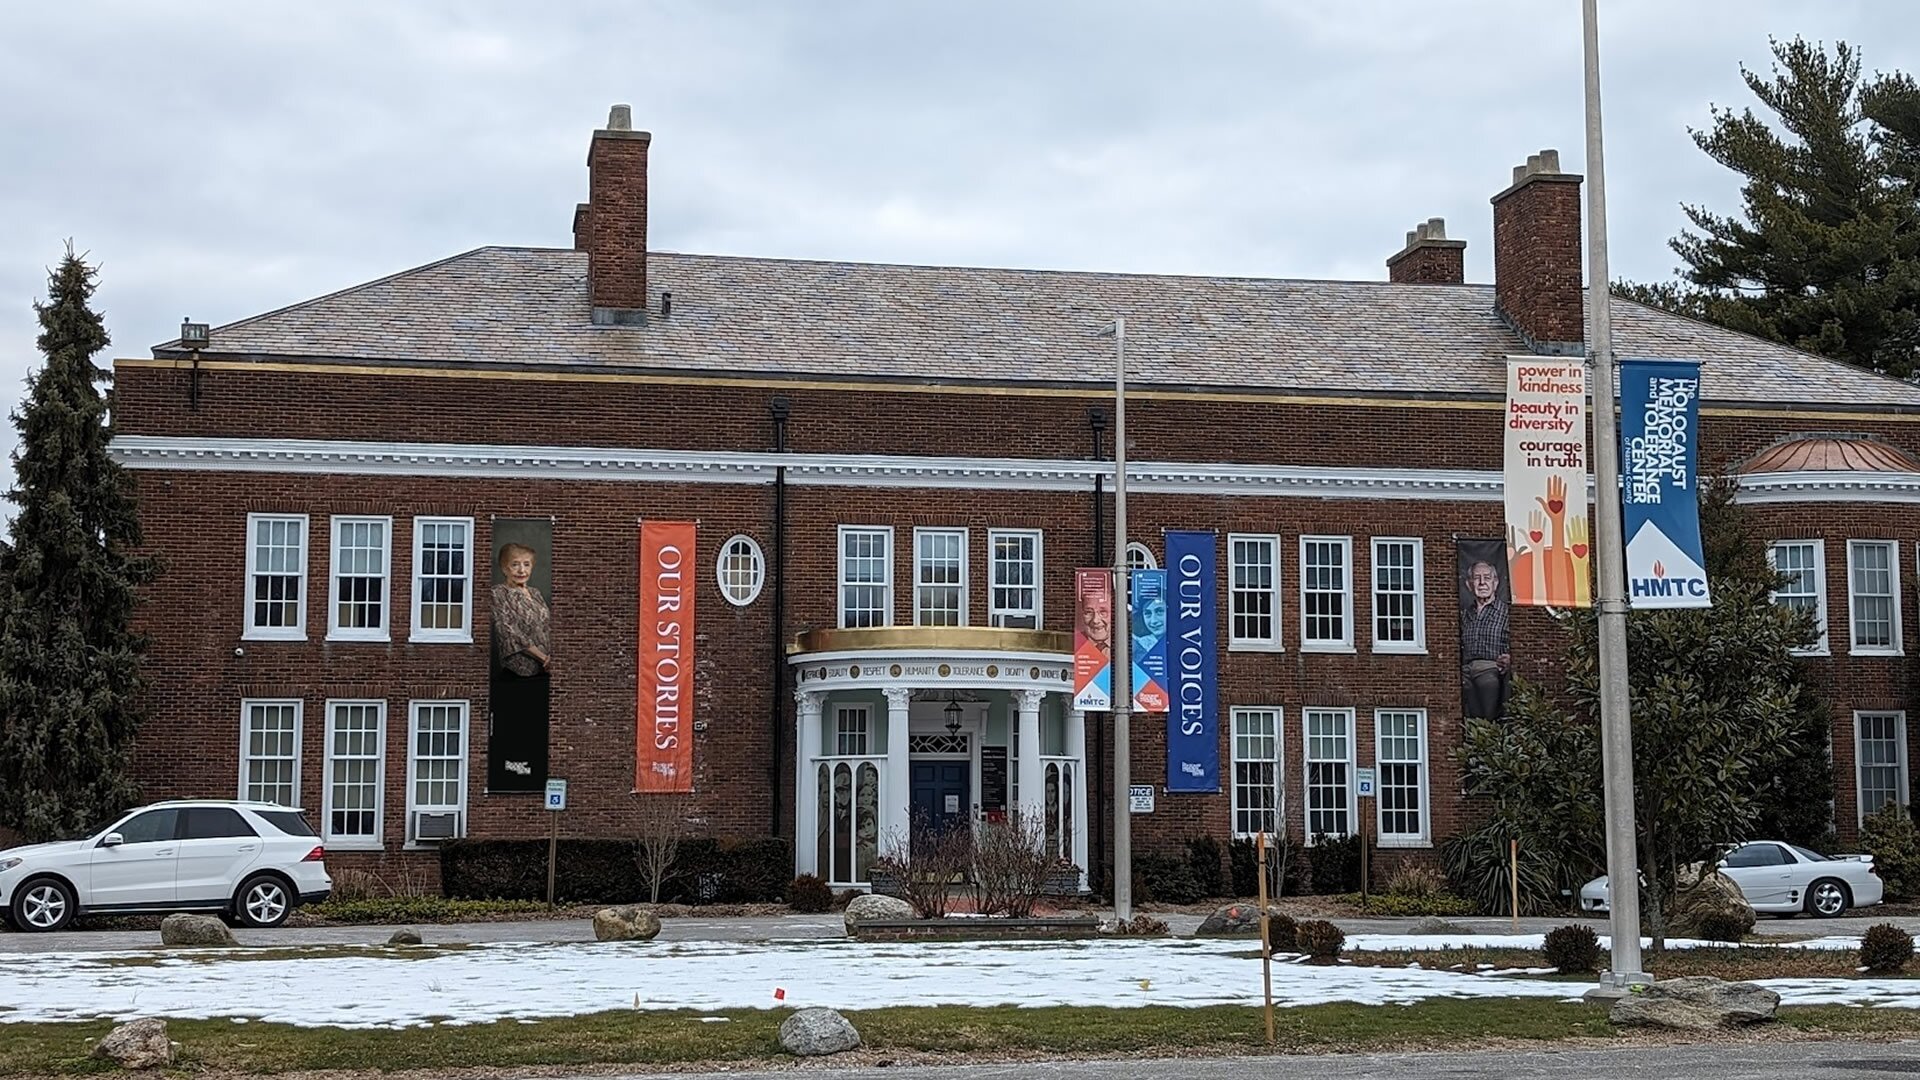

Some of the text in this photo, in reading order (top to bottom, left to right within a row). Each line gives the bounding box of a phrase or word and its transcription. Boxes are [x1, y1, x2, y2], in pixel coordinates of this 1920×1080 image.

[1518, 363, 1582, 380] power in
[1519, 378, 1582, 393] kindness
[1687, 378, 1698, 399] The
[1510, 398, 1579, 419] beauty in
[1509, 414, 1574, 434] diversity
[1658, 378, 1675, 477] MEMORIAL
[1671, 378, 1689, 490] HOLOCAUST
[1519, 441, 1582, 455] courage
[1644, 377, 1661, 504] and TOLERANCE
[1527, 453, 1582, 467] in truth
[1631, 437, 1647, 504] CENTER
[656, 545, 682, 613] OUR
[1178, 554, 1202, 620] OUR
[1632, 578, 1706, 597] HMTC
[862, 666, 886, 676] RESPECT
[904, 666, 935, 676] HUMANITY
[952, 667, 985, 677] TOLERANCE
[1179, 626, 1203, 736] VOICES
[654, 621, 680, 750] STORIES
[1079, 698, 1105, 706] HMTC
[1130, 788, 1152, 796] OTICE
